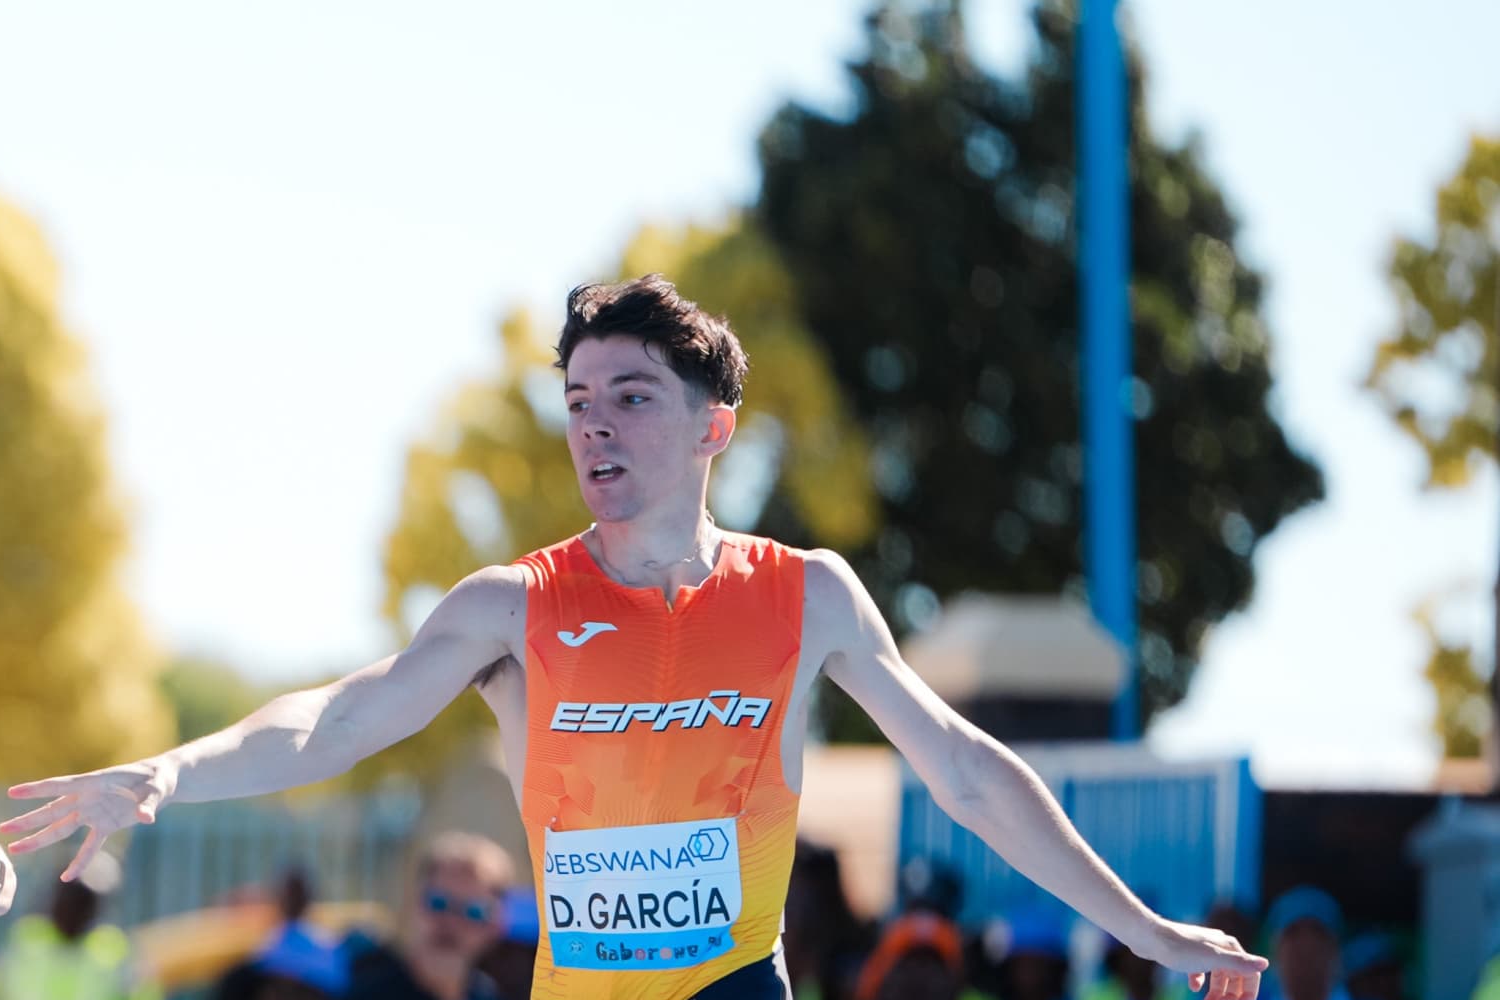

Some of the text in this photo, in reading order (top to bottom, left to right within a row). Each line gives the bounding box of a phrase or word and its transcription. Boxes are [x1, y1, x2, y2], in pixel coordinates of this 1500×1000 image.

[550, 690, 772, 733] ESPAÑA
[550, 879, 731, 930] D. GARCÍA
